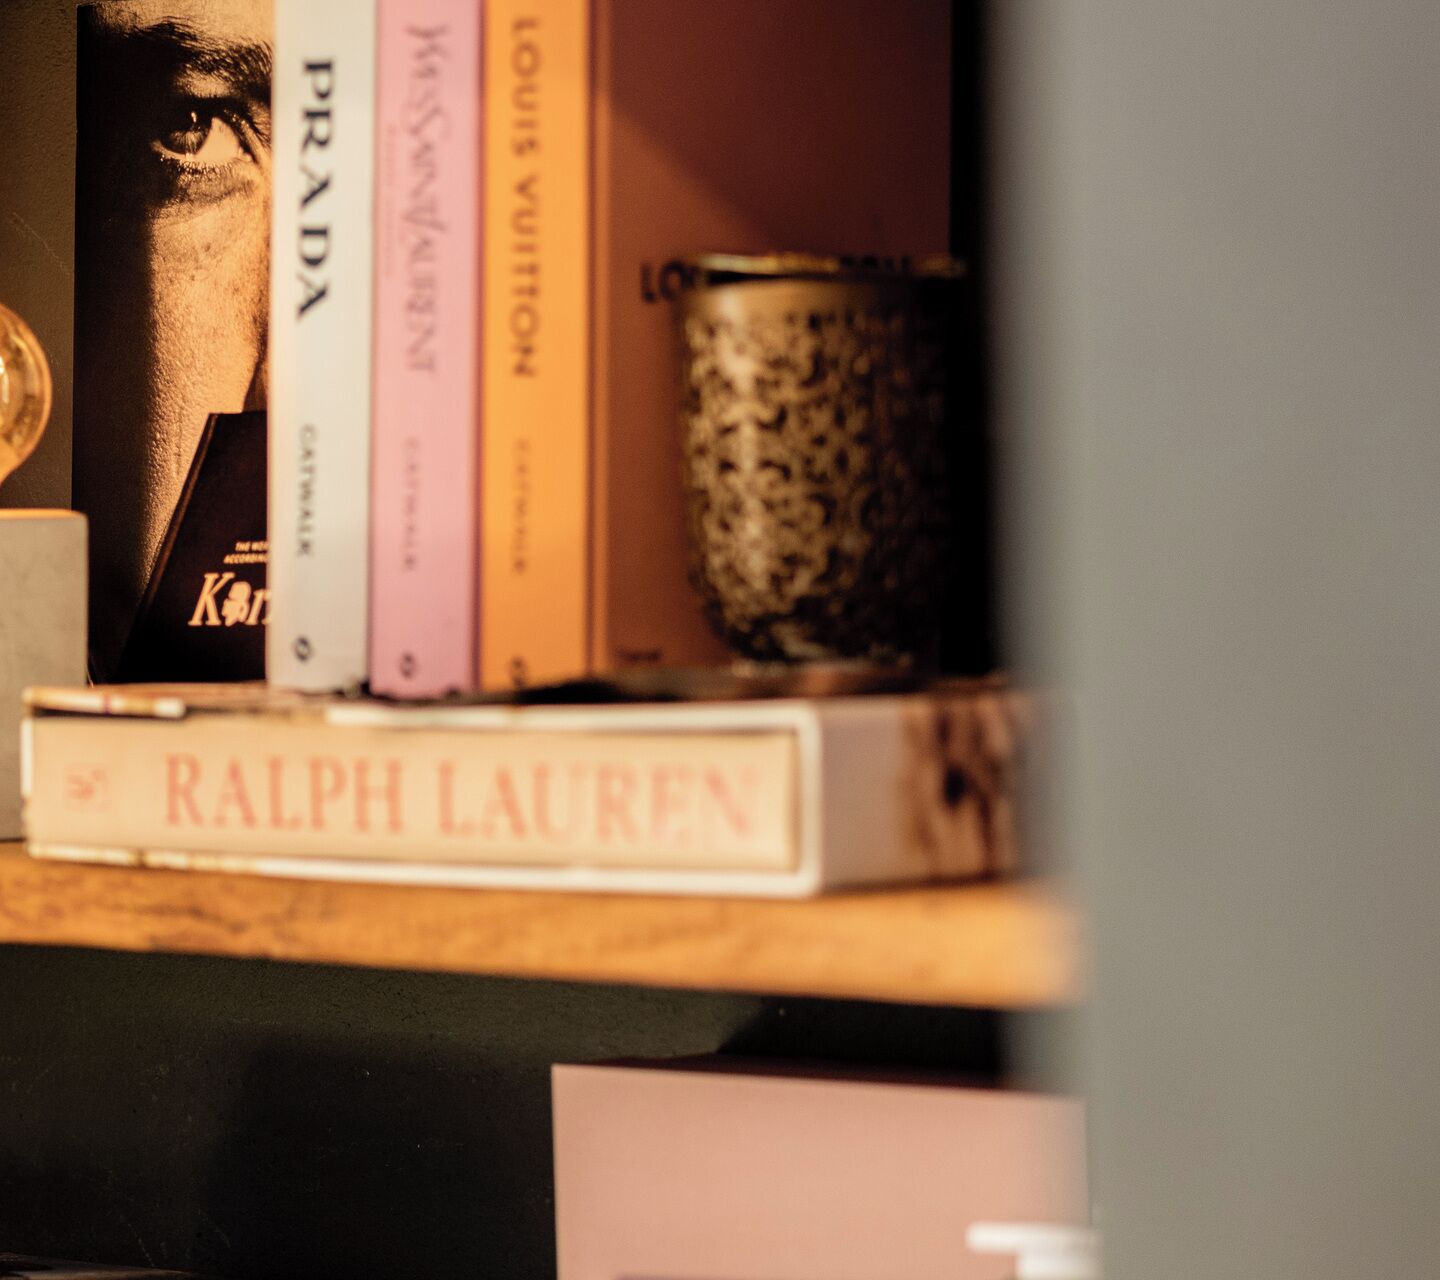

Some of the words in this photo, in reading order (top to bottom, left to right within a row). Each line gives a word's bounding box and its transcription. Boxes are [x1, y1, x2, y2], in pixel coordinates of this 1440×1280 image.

[512, 14, 542, 158] LOUIS
[296, 56, 337, 322] PRADA
[511, 172, 539, 378] VUITTON
[298, 424, 319, 561] CATWALK
[164, 754, 404, 839] RALPH
[438, 756, 761, 847] LAUREN
